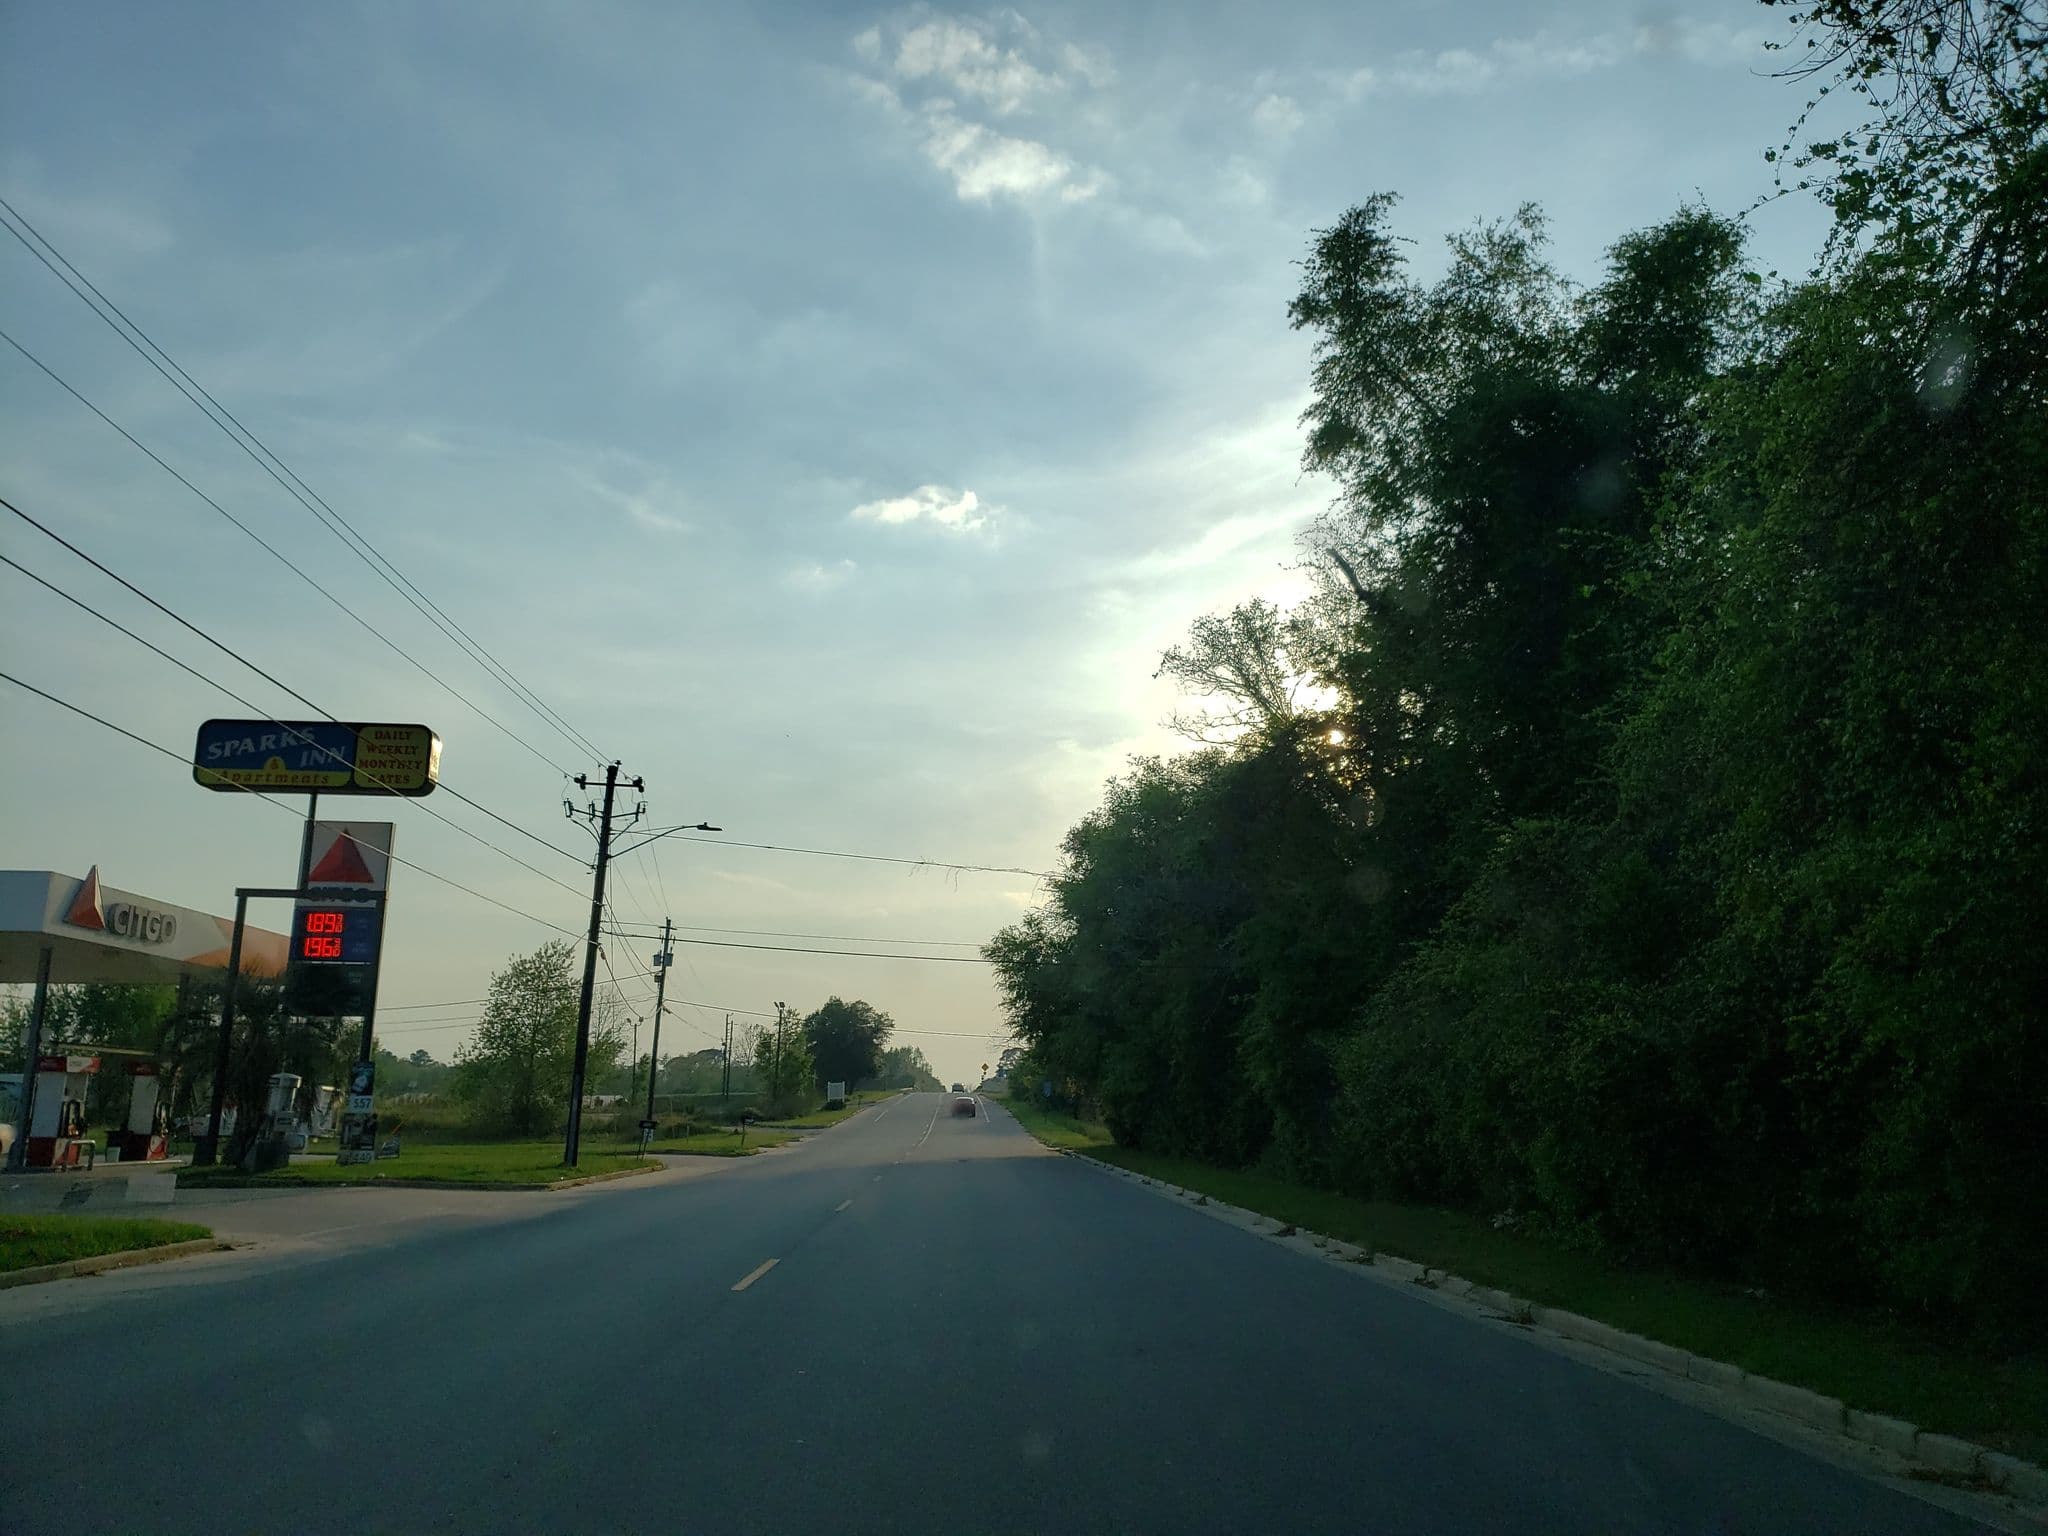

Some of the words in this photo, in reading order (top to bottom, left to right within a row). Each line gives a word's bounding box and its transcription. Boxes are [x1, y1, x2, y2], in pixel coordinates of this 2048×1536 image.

[374, 730, 413, 740] DAILY
[207, 727, 315, 760] SPARKS
[366, 743, 419, 755] WEEKLY
[300, 745, 345, 768] INN
[359, 758, 423, 770] MONTHLY
[217, 770, 329, 784] Apartments
[367, 774, 411, 784] RATES
[108, 903, 177, 943] CITGO
